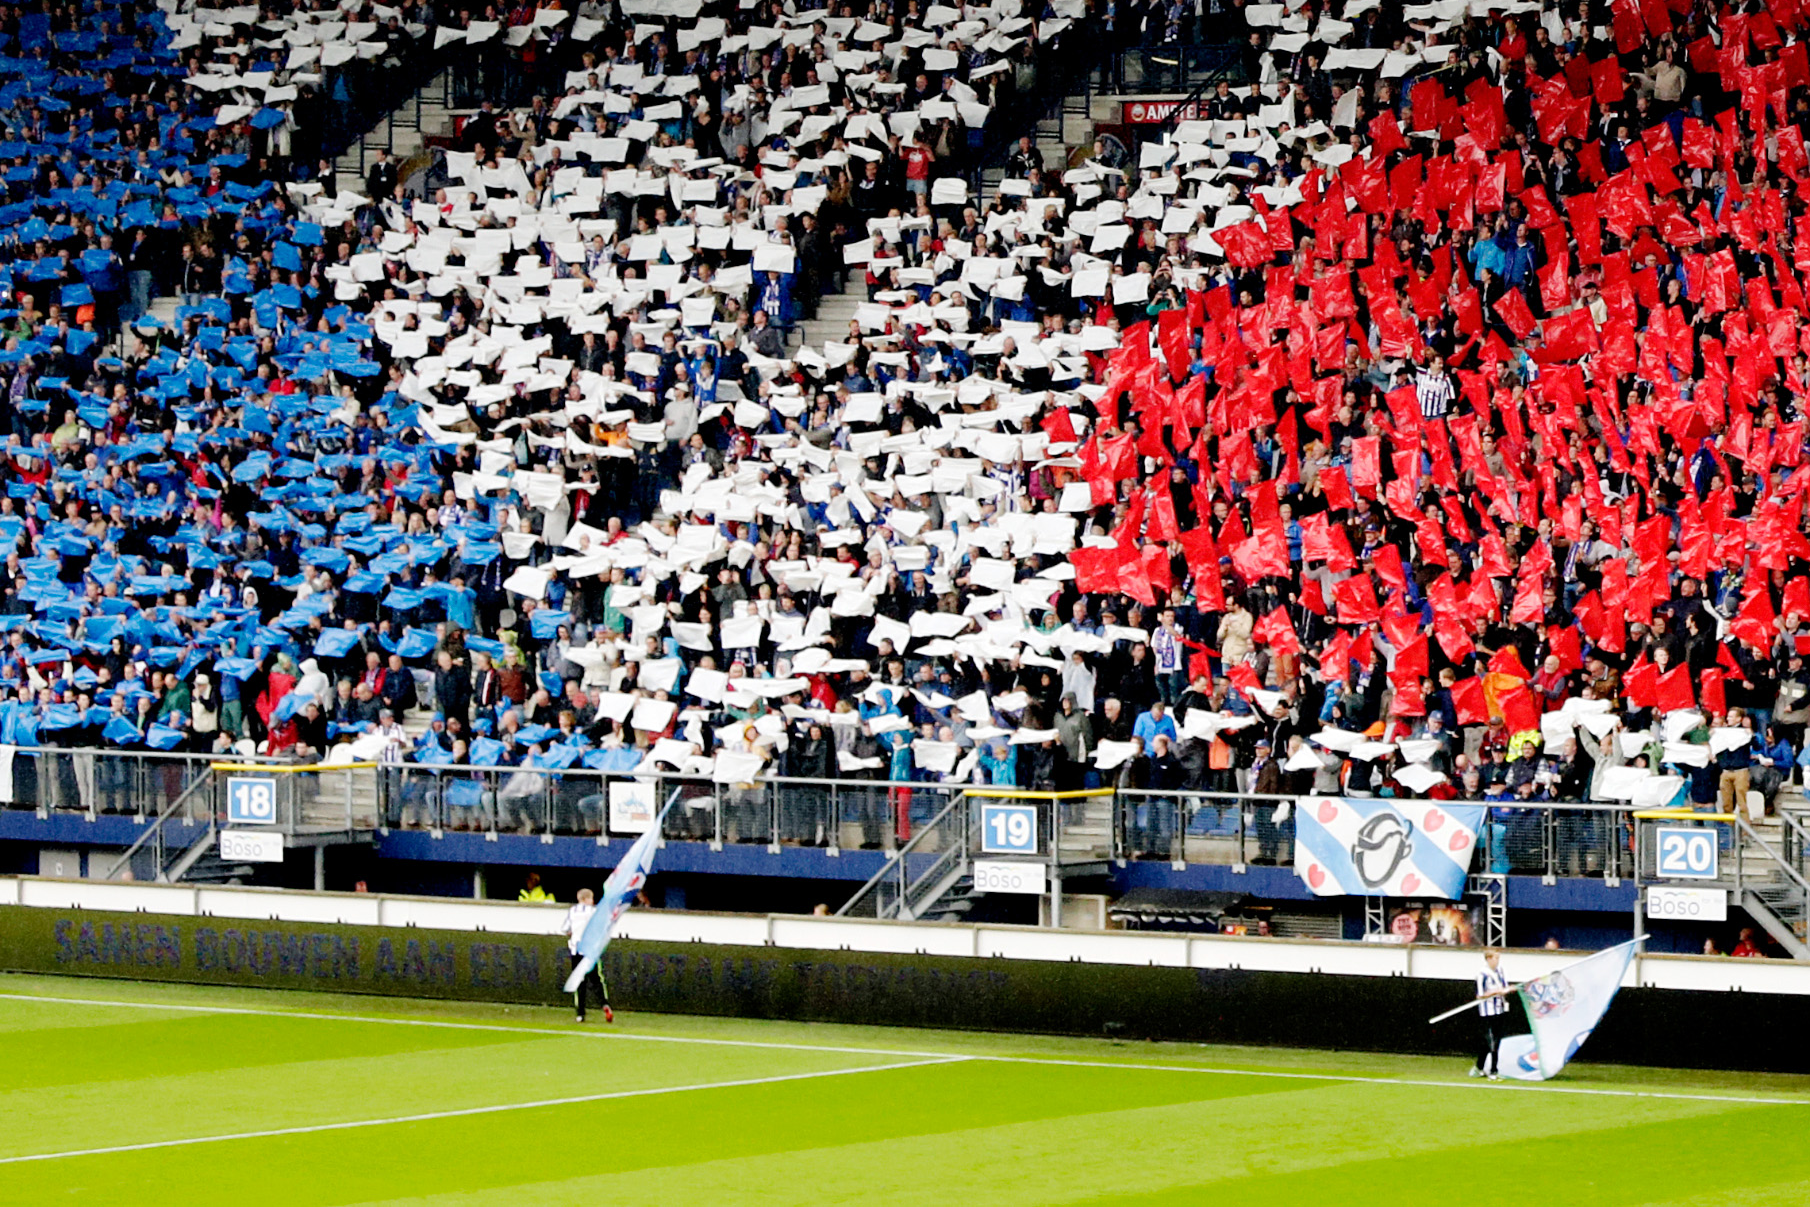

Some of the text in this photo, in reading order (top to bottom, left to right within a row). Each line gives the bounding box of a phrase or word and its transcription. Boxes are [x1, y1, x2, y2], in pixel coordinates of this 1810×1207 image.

[235, 784, 270, 817] 18
[991, 813, 1029, 847] 19
[1662, 836, 1711, 873] 20
[976, 869, 1022, 889] Boso
[1649, 895, 1701, 916] Boso
